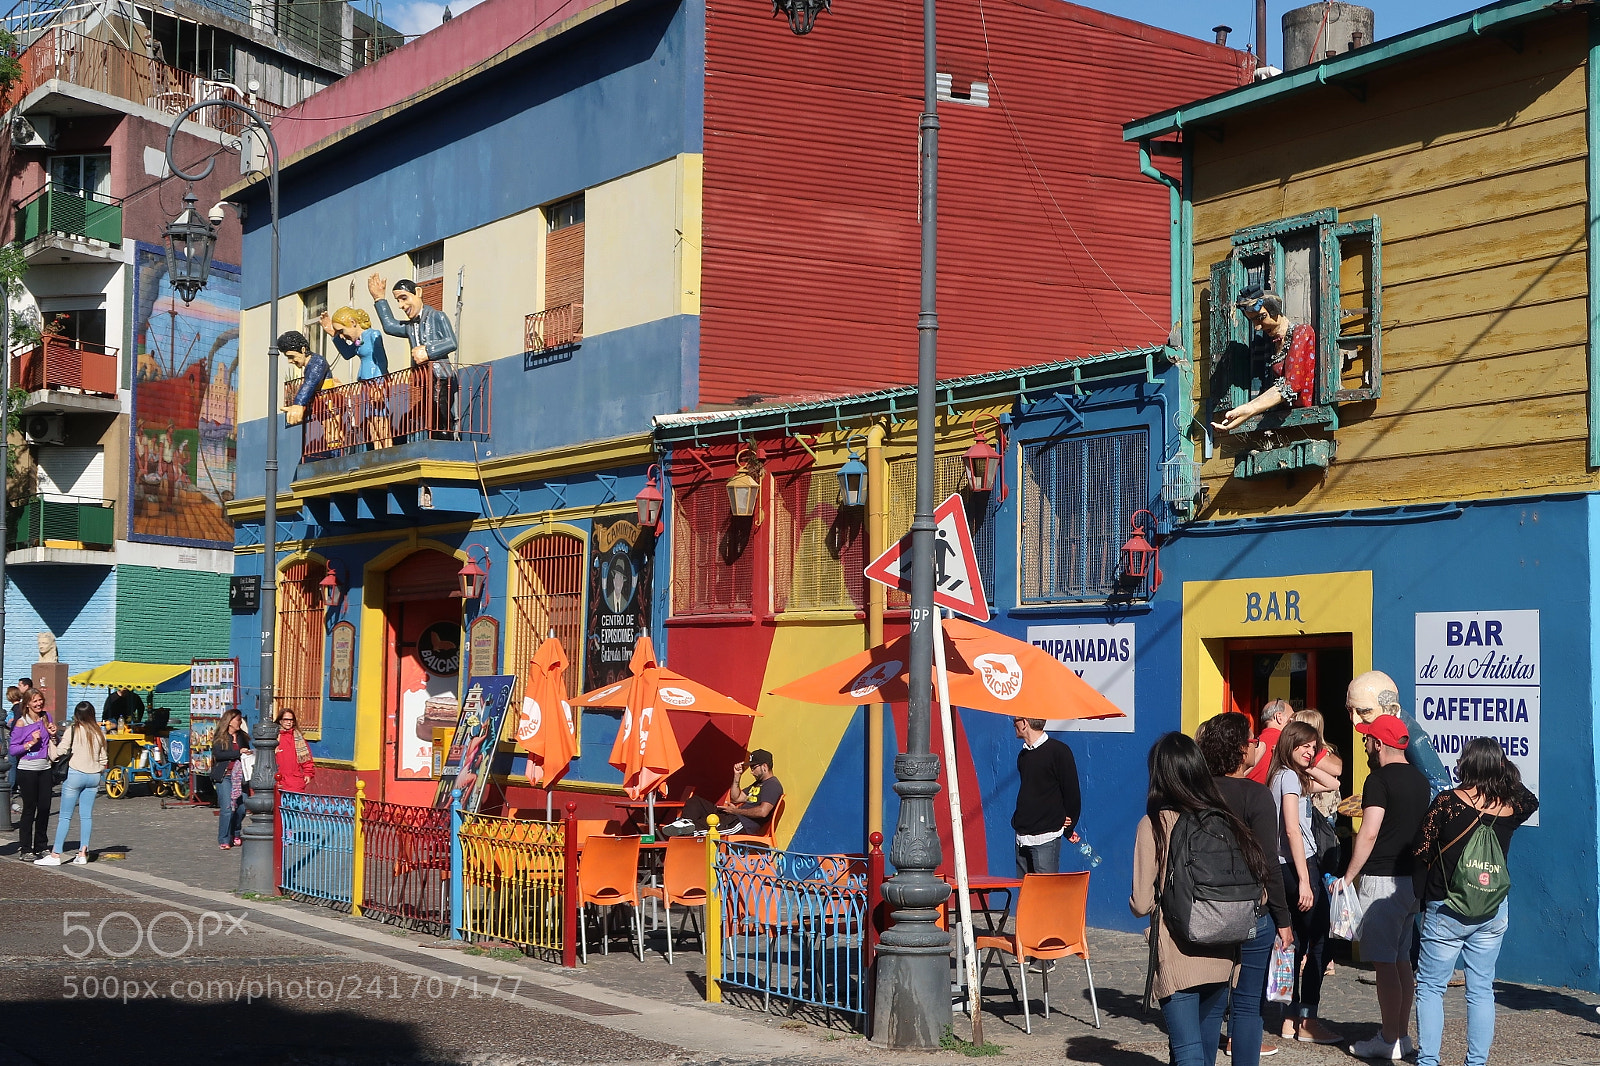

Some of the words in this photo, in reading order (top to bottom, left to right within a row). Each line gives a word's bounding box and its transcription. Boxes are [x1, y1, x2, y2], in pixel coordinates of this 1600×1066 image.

[606, 520, 637, 545] CAMINITO
[601, 614, 625, 626] CENTRO
[625, 614, 634, 625] DE
[1240, 590, 1306, 623] BAR
[601, 628, 634, 644] EXPOSICIONES
[1446, 620, 1504, 647] BAR
[1032, 637, 1130, 662] MPANADAS
[1419, 654, 1438, 679] de
[1443, 654, 1464, 679] los
[1467, 650, 1535, 679] Artistas
[982, 666, 1020, 696] BALCARCE
[1422, 696, 1529, 723] CAFETERIA
